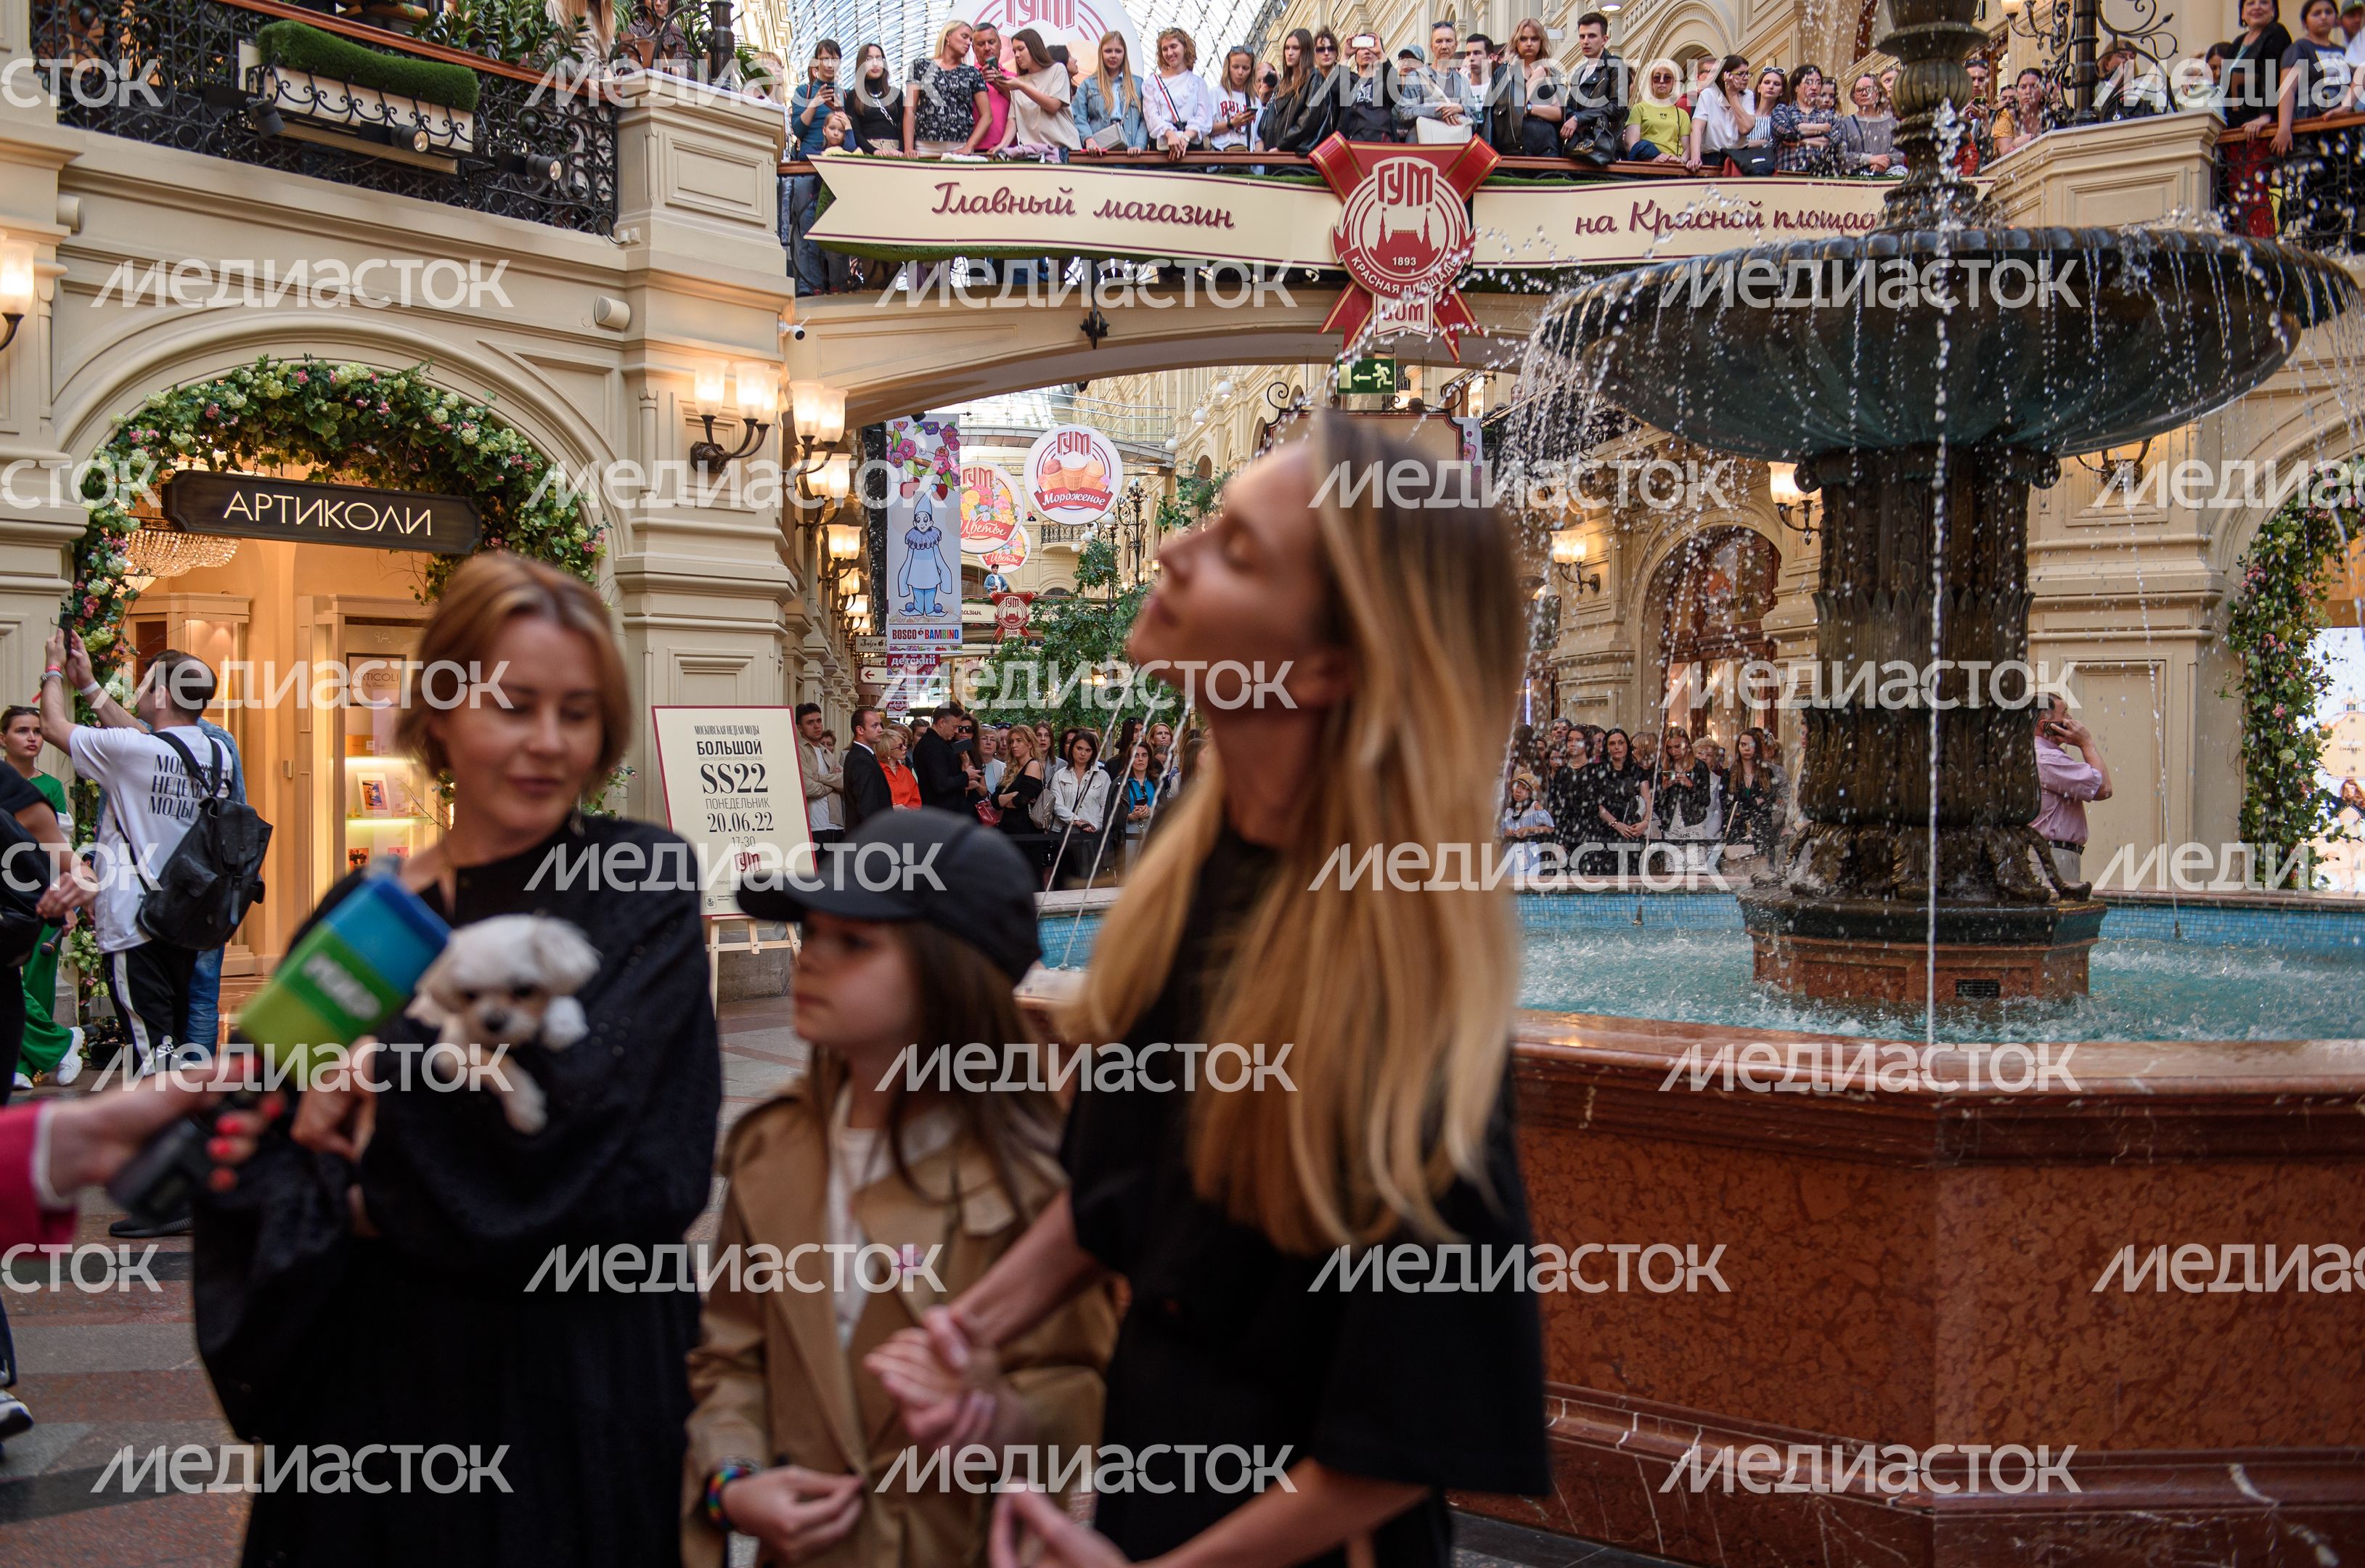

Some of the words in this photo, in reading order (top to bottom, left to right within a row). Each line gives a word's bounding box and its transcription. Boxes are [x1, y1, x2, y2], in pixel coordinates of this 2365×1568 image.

[1378, 162, 1433, 207] ГУМ
[931, 181, 1076, 216] Главный
[1093, 197, 1236, 229] магазин
[1575, 213, 1618, 235] на
[1628, 198, 1765, 241] Красной
[1773, 208, 1877, 237] площад
[1392, 256, 1417, 266] 1893
[1351, 256, 1400, 294] КРАСНАЯ
[1404, 258, 1459, 294] ПЛОЩАДЬ
[1057, 430, 1092, 456] ГУМ
[962, 467, 995, 489] ГУМ
[1042, 491, 1106, 506] Мороженое
[223, 490, 432, 536] АРТИКОЛИ
[960, 514, 1007, 539] Цветы
[985, 550, 1020, 564] Цветы
[1005, 597, 1019, 608] ГУМ
[892, 629, 917, 640] BOSCO
[924, 629, 959, 640] BAMBINO
[891, 654, 936, 666] детский
[354, 672, 399, 682] ARTICOLI
[694, 725, 726, 735] МОСКОВСКАЯ
[726, 725, 744, 736] НЕДЕЛЯ
[745, 725, 759, 735] МОДЫ
[696, 739, 763, 756] БОЛЬШОЙ
[151, 775, 203, 799] НЕДЕЛЯ
[700, 763, 768, 794] SS22
[147, 795, 195, 820] МОДЫ
[706, 797, 770, 810] ПОНЕДЕЛЬНИК
[707, 812, 775, 833] 20.06.22
[732, 836, 756, 848] 17-30
